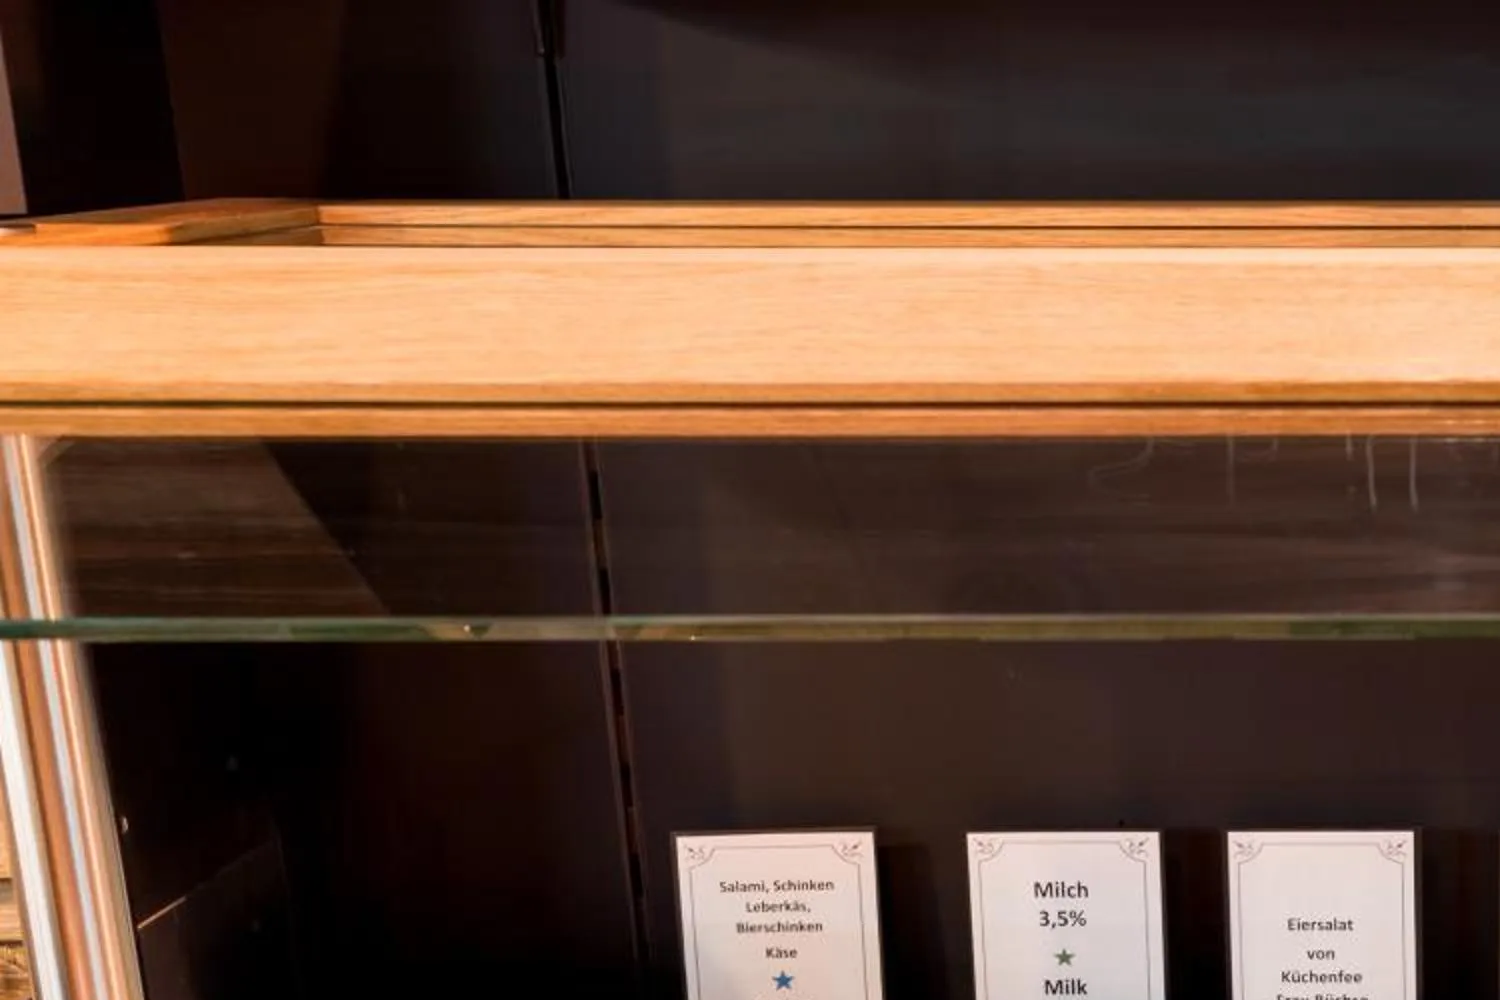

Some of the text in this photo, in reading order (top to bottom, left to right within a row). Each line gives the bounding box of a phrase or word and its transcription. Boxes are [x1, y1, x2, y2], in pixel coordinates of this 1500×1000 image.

[718, 879, 835, 894] Salami, Schinken
[1033, 881, 1089, 899] Milch
[1038, 910, 1088, 929] 3,5%
[1286, 917, 1355, 932] Eiersalat
[736, 921, 824, 934] Bierschinken
[765, 946, 799, 959] Käse
[1306, 949, 1336, 961] von
[1280, 969, 1363, 984] Küchenfee
[1044, 978, 1089, 996] Milk
